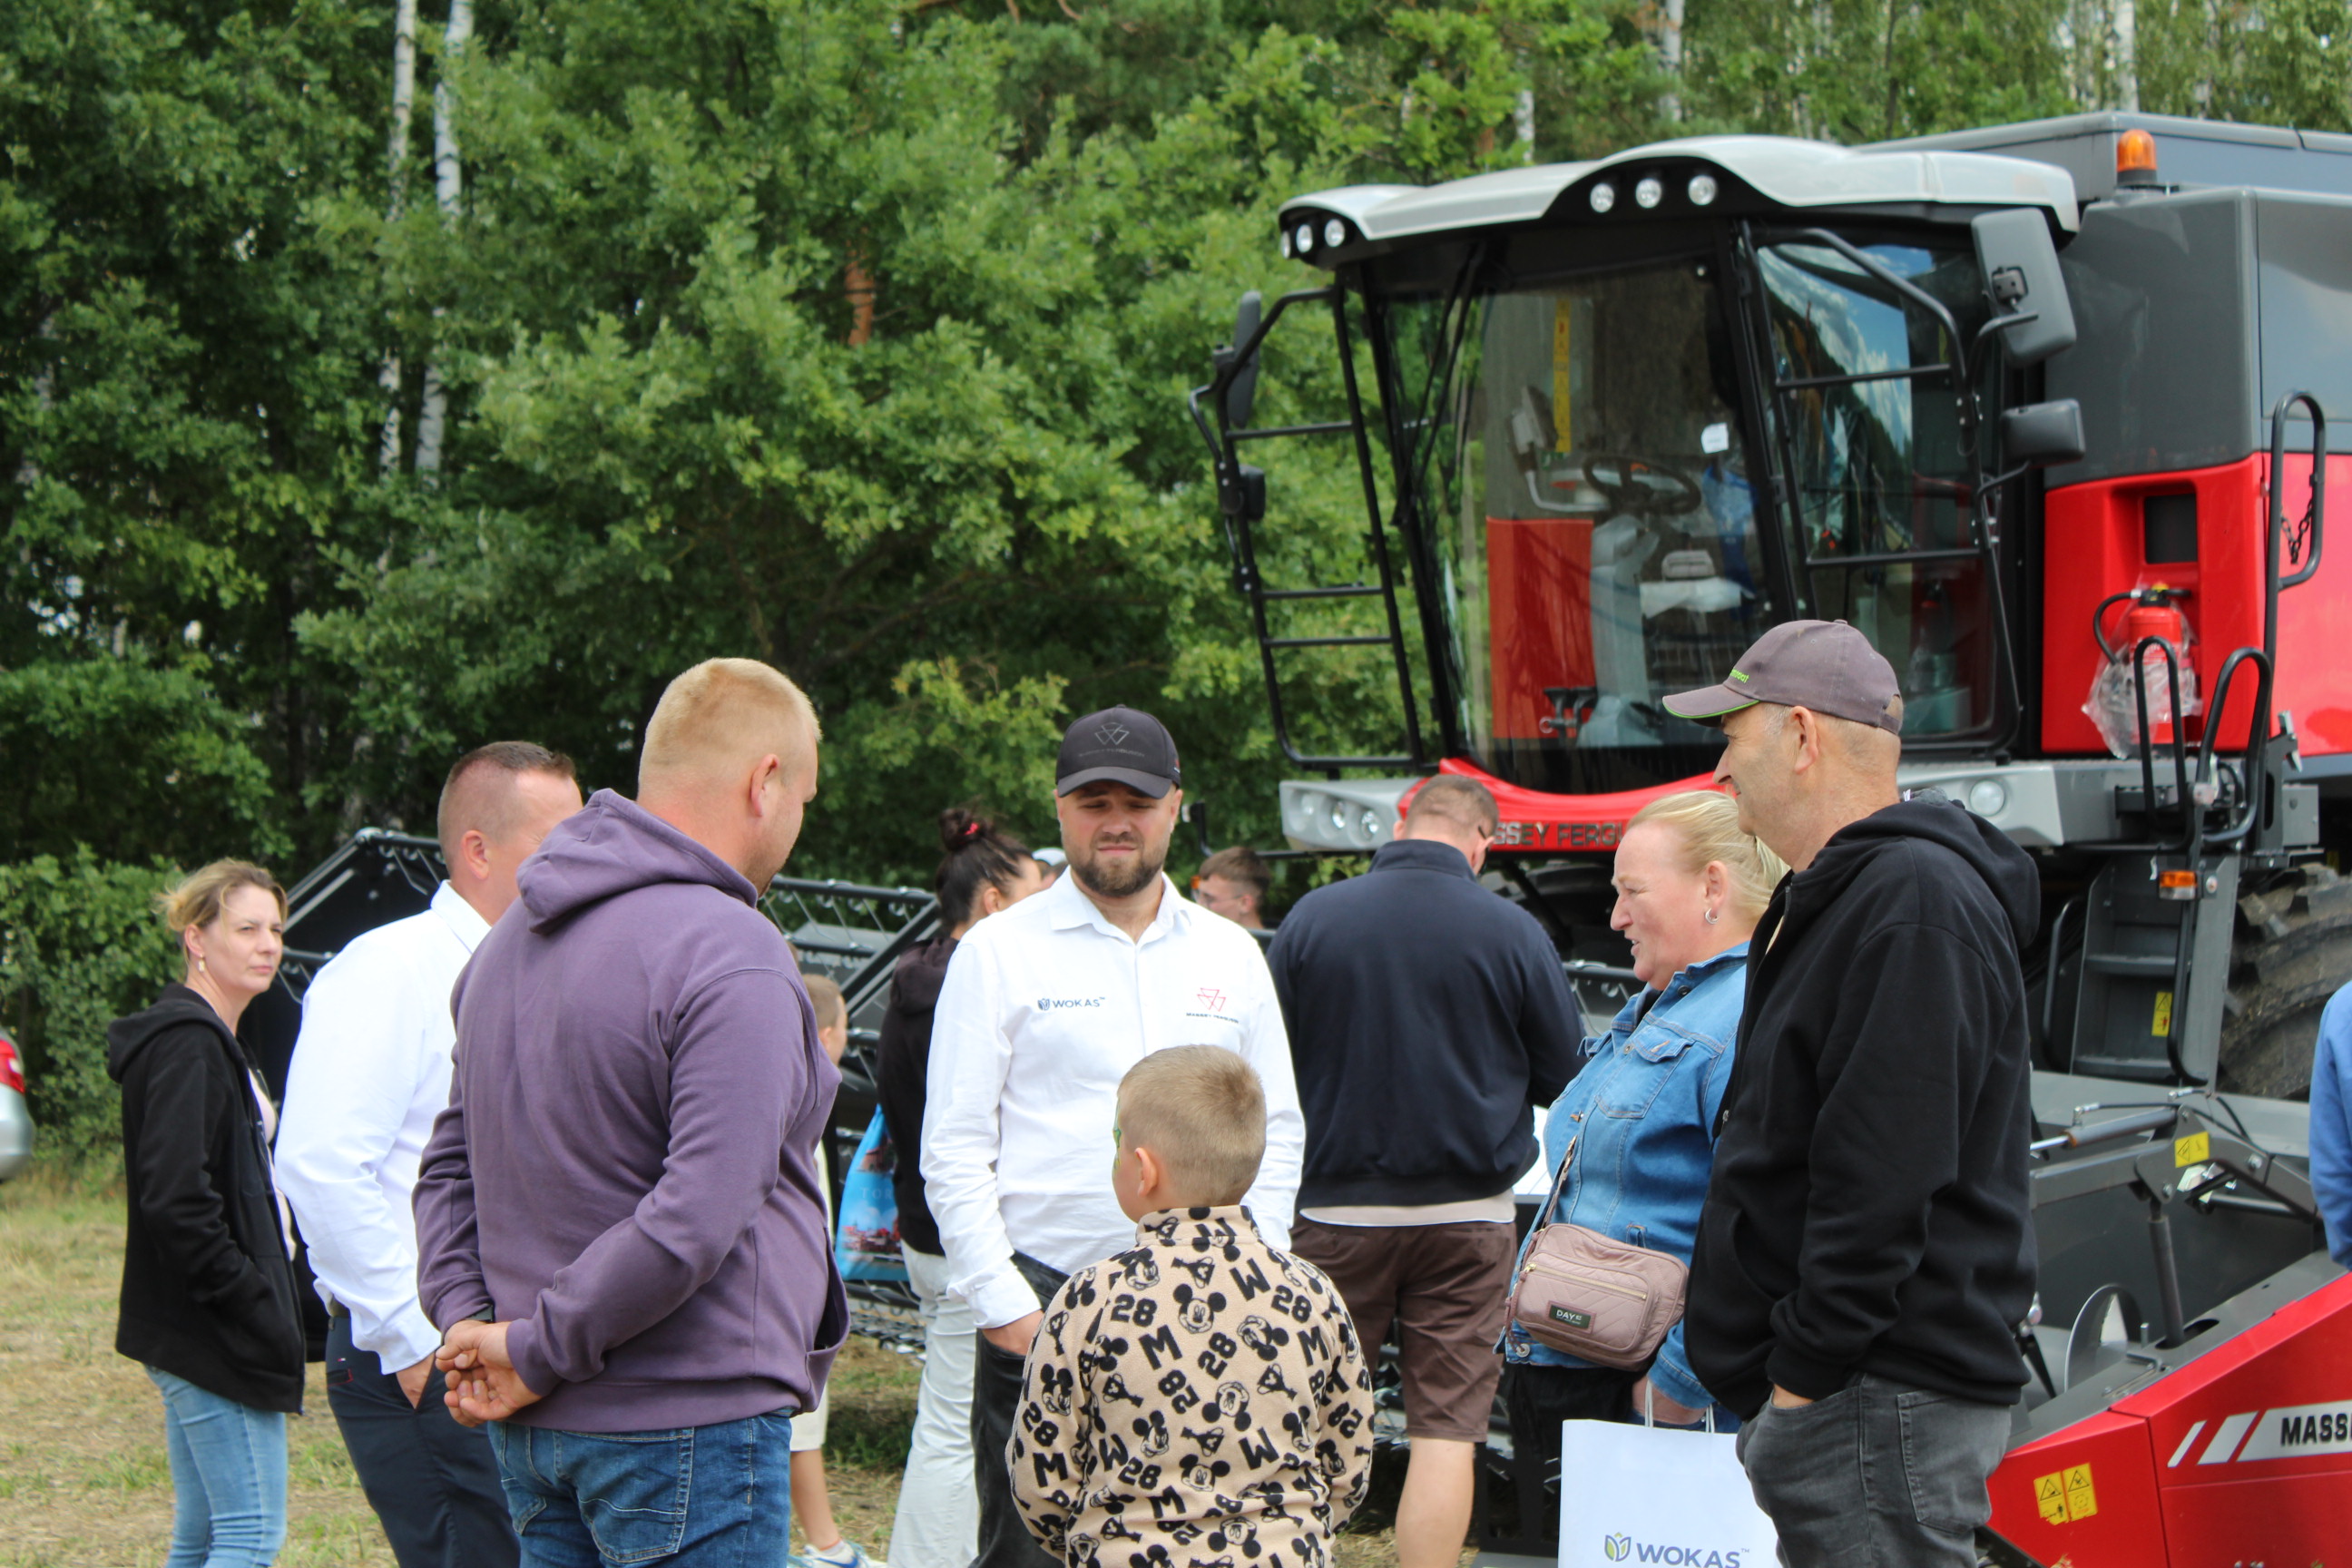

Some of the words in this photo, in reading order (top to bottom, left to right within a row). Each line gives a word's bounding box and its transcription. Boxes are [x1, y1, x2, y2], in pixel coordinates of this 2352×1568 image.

[1494, 821, 1550, 845] SSEY
[1557, 822, 1624, 846] FERG
[859, 1187, 893, 1199] TOR
[1110, 1294, 1158, 1328] 28
[1270, 1285, 1312, 1324] 28
[1139, 1325, 1182, 1370] M
[1198, 1331, 1238, 1380] 28
[1297, 1326, 1329, 1367] M
[1022, 1401, 1060, 1447] 28
[2280, 1413, 2352, 1446] MASS
[1033, 1452, 1068, 1488] M
[1117, 1456, 1161, 1491] 28
[1146, 1485, 1187, 1519] M
